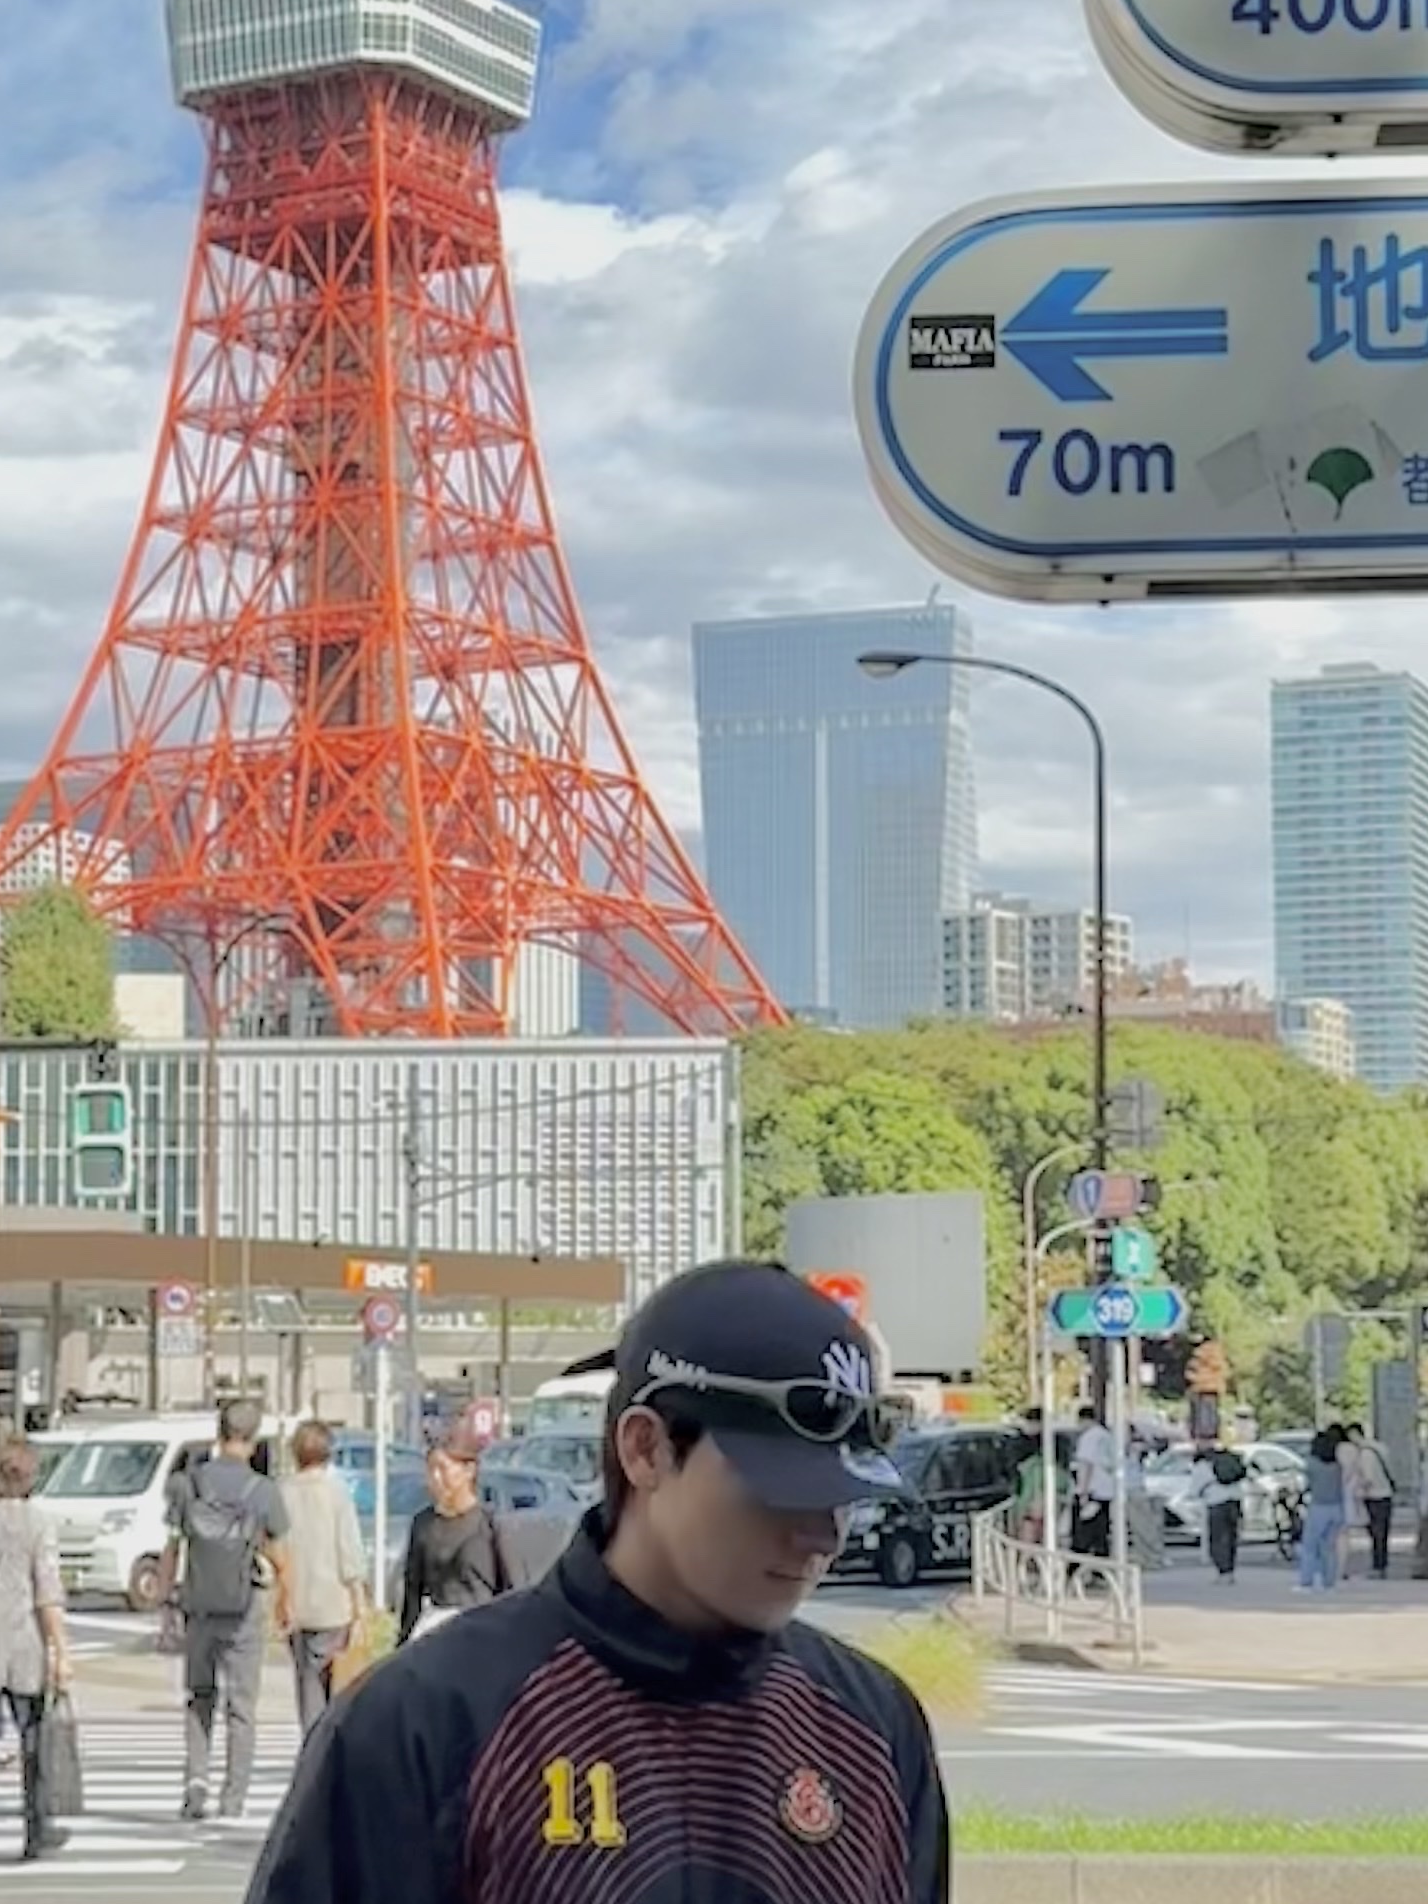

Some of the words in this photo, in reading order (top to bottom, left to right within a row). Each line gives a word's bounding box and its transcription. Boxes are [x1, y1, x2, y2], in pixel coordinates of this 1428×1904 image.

[911, 327, 994, 353] MAFIA
[998, 427, 1175, 496] 70m
[1097, 1295, 1135, 1324] 319
[541, 1756, 628, 1848] 11
